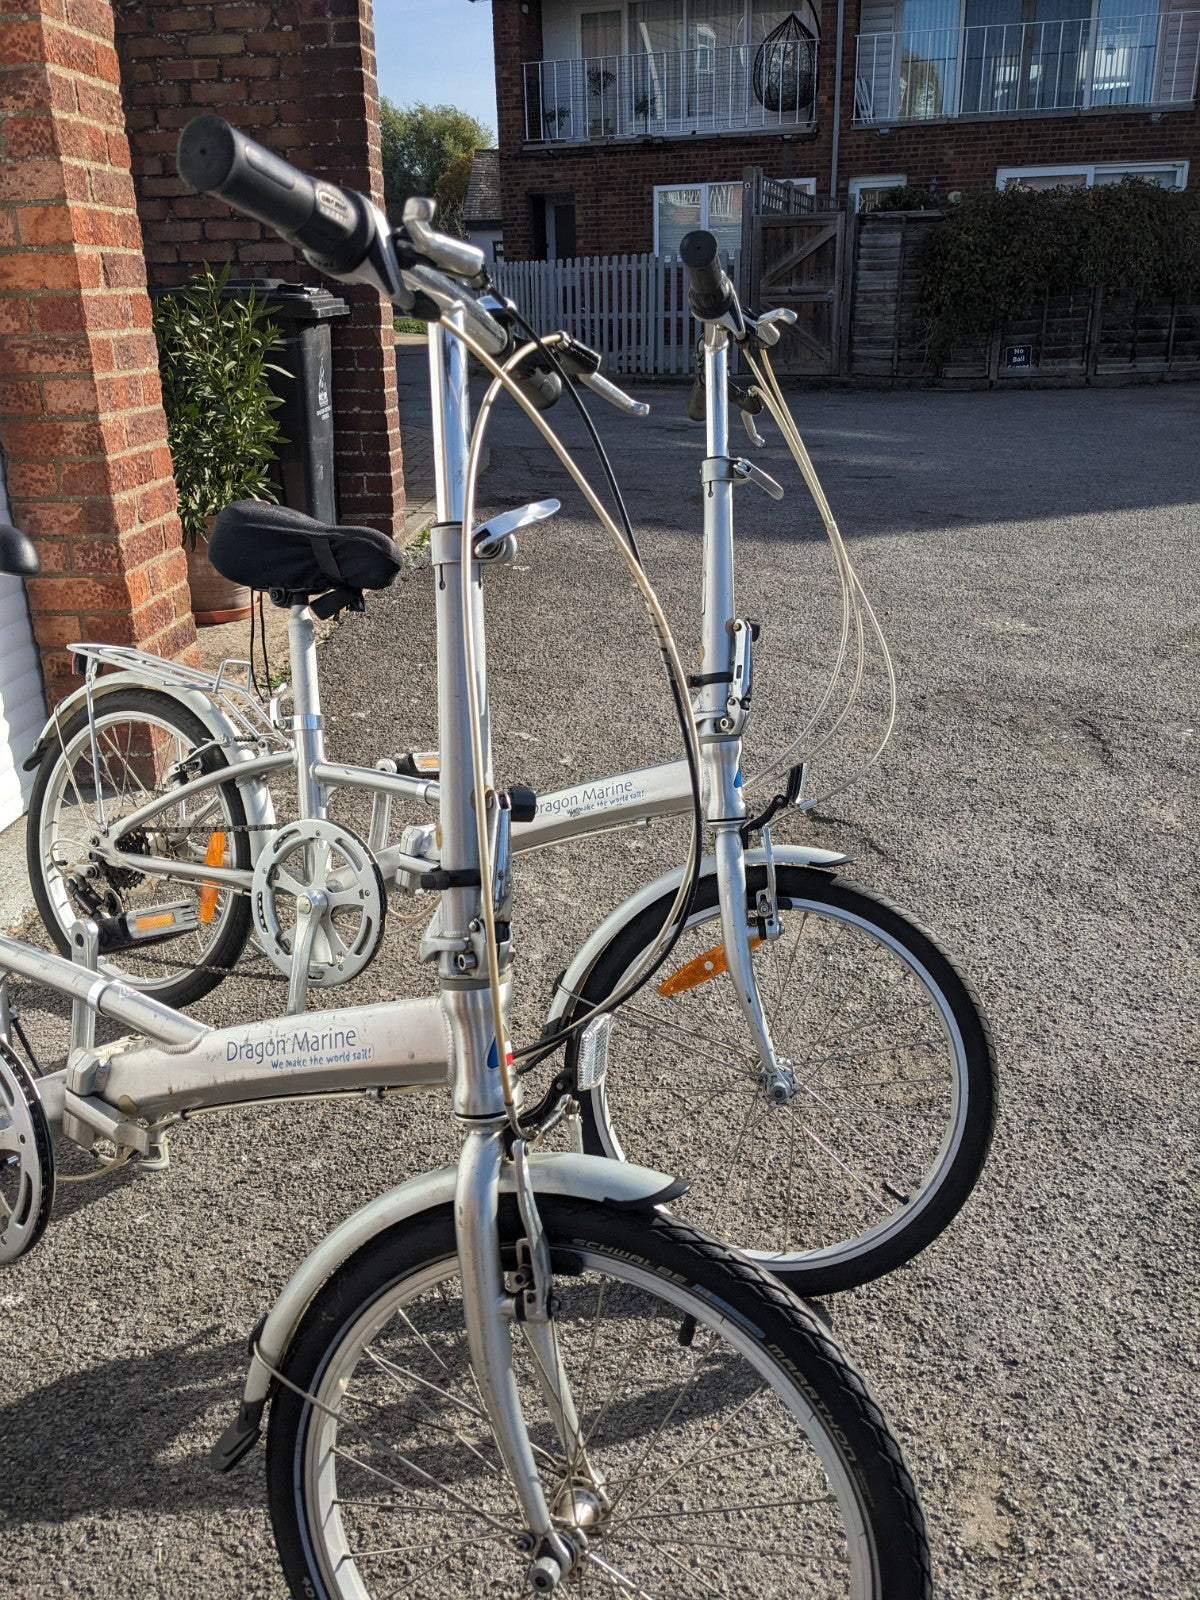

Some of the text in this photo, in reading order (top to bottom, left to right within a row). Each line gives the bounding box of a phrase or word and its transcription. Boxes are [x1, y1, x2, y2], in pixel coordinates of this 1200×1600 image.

[1012, 355, 1025, 363] Ball
[582, 782, 632, 802] Marine
[597, 800, 608, 808] the
[610, 795, 629, 805] world
[630, 790, 645, 800] sail!
[227, 1028, 356, 1064] Dragon Marine
[271, 1048, 372, 1070] We make the world sail!
[572, 1238, 687, 1283] SCHWALBE
[768, 1344, 857, 1463] MARATHON
